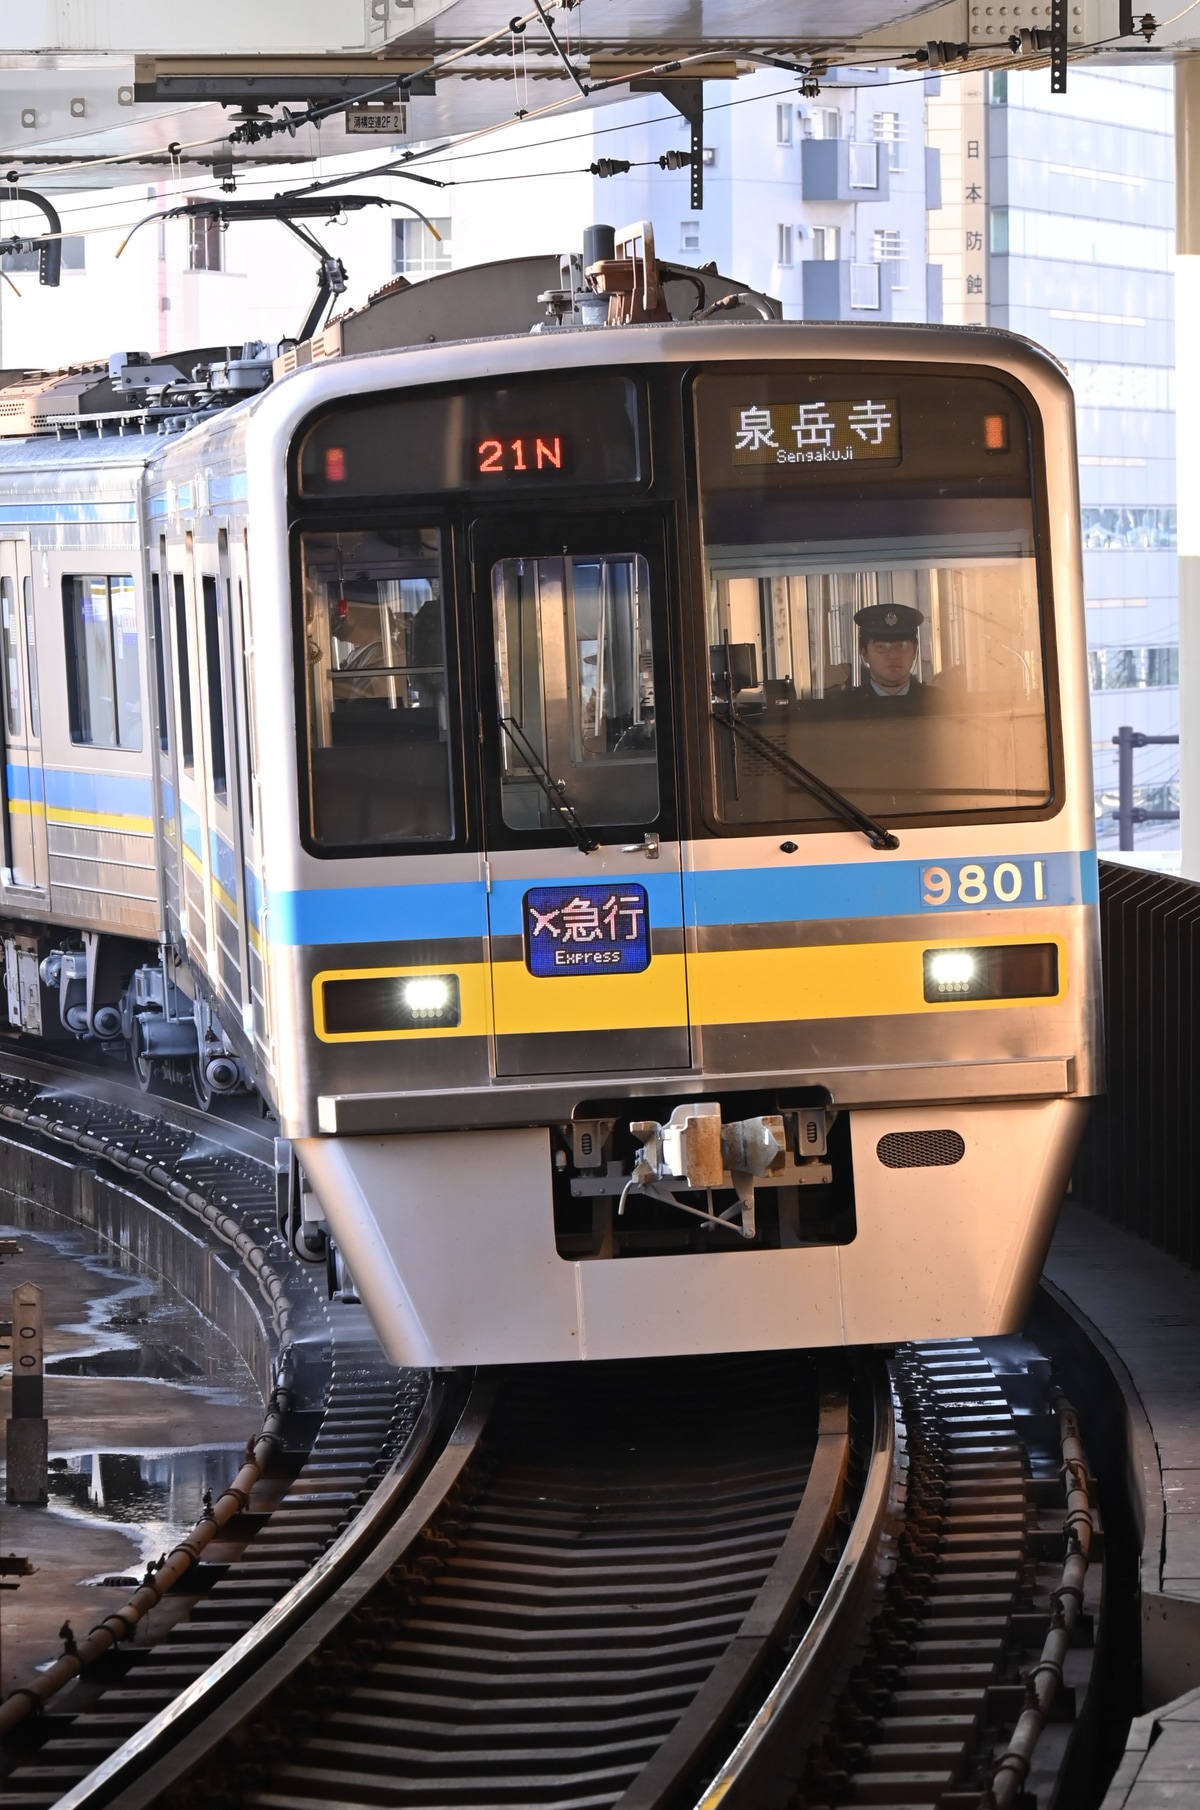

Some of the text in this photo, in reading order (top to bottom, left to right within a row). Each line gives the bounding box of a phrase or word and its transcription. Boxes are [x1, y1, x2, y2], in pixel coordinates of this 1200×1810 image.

[393, 115, 399, 128] 2
[965, 140, 983, 326] 日本防蝕
[735, 400, 892, 450] 泉岳寺
[478, 437, 561, 472] 21N
[776, 446, 853, 463] Sengakuji
[923, 860, 1044, 905] 9801
[561, 896, 644, 942] 急行
[555, 950, 621, 965] Express
